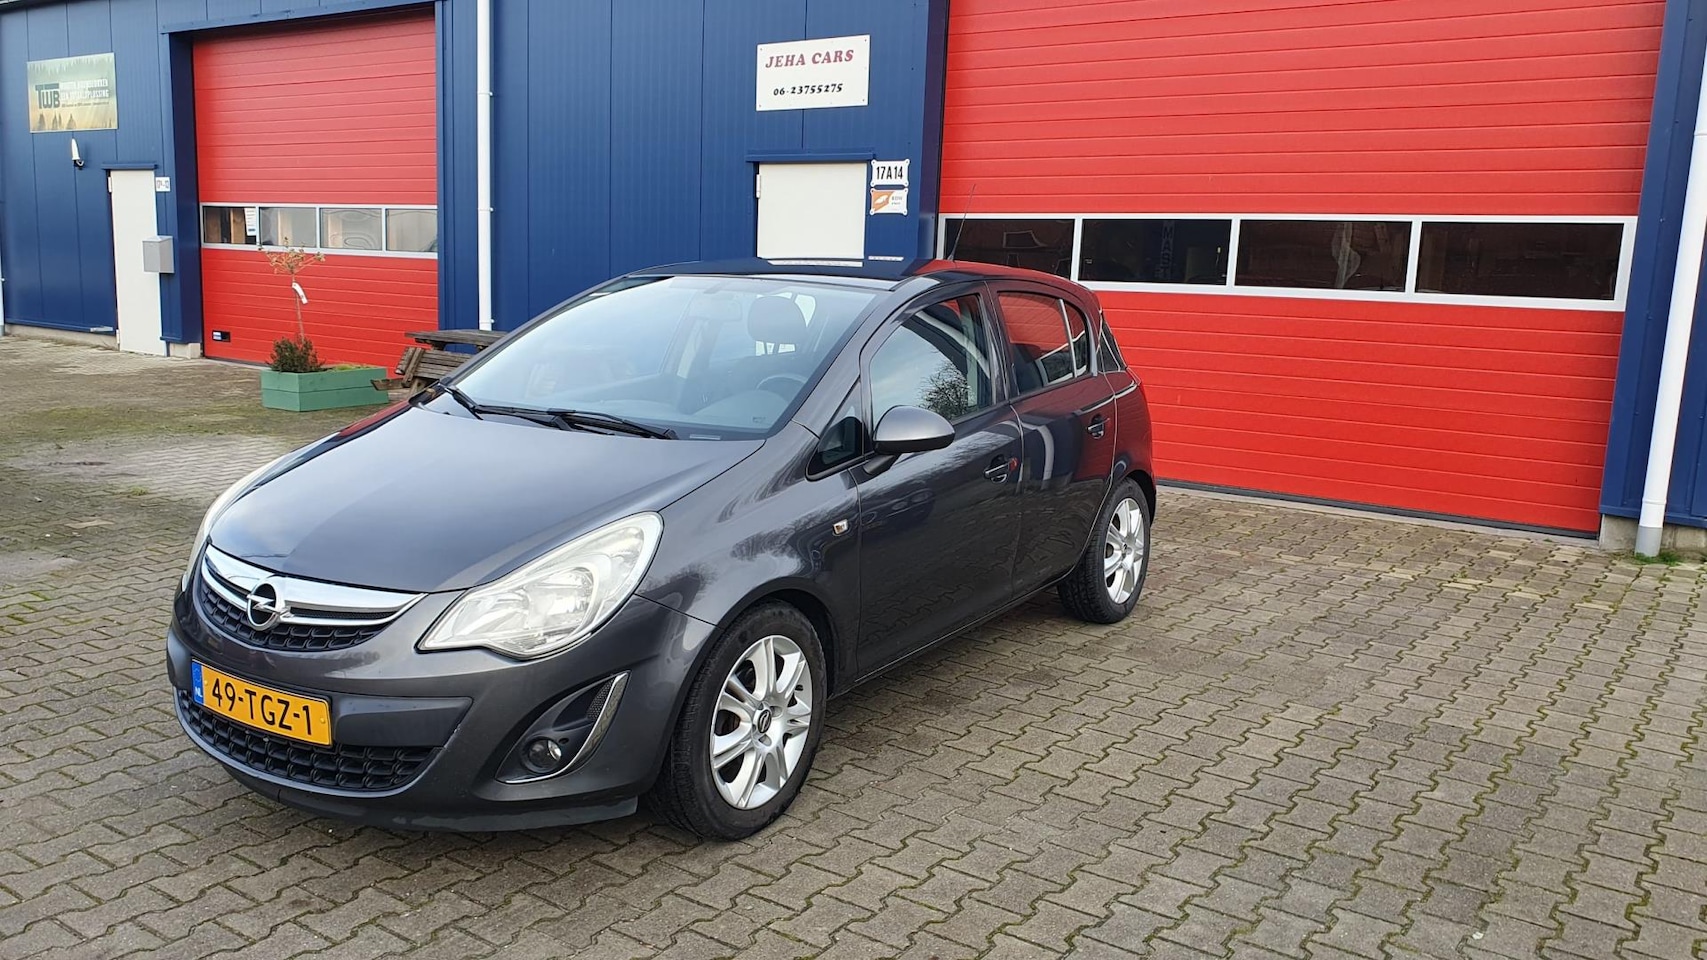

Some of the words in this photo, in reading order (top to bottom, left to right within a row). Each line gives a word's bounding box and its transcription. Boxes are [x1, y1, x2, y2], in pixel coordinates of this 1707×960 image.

[765, 53, 806, 68] JEHA
[811, 49, 854, 65] CARS
[35, 83, 60, 109] TWB
[876, 166, 903, 180] 17A14
[194, 686, 203, 698] NL
[212, 677, 312, 736] 49-TGZ-1
